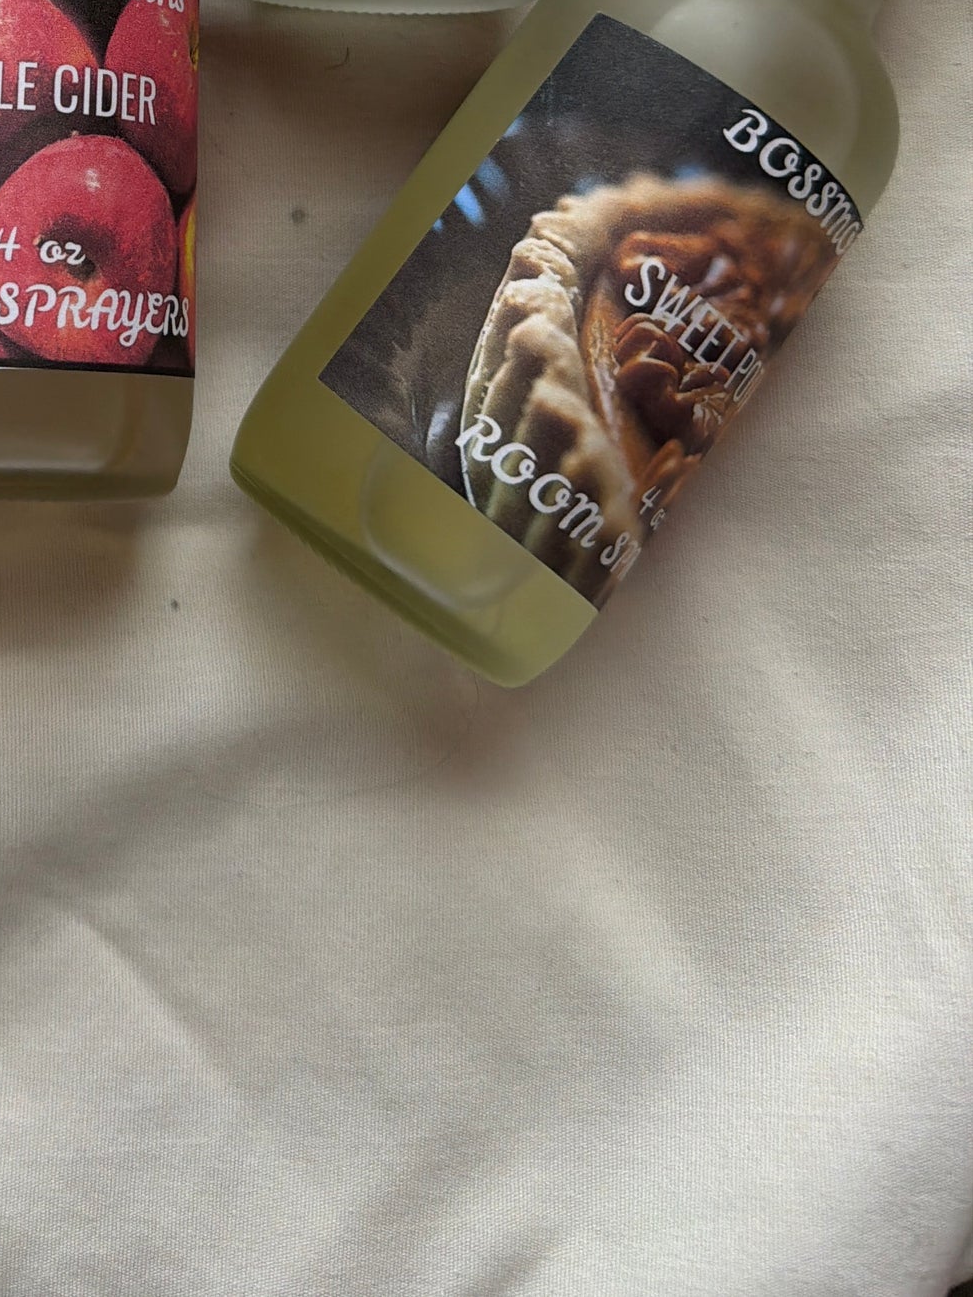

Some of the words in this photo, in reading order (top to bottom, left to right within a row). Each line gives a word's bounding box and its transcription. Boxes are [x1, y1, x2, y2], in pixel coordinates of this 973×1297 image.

[53, 64, 158, 126] CIDER
[39, 237, 86, 266] oz
[624, 256, 745, 375] SWEET
[454, 414, 605, 549] ROOM
[639, 485, 662, 515] 4
